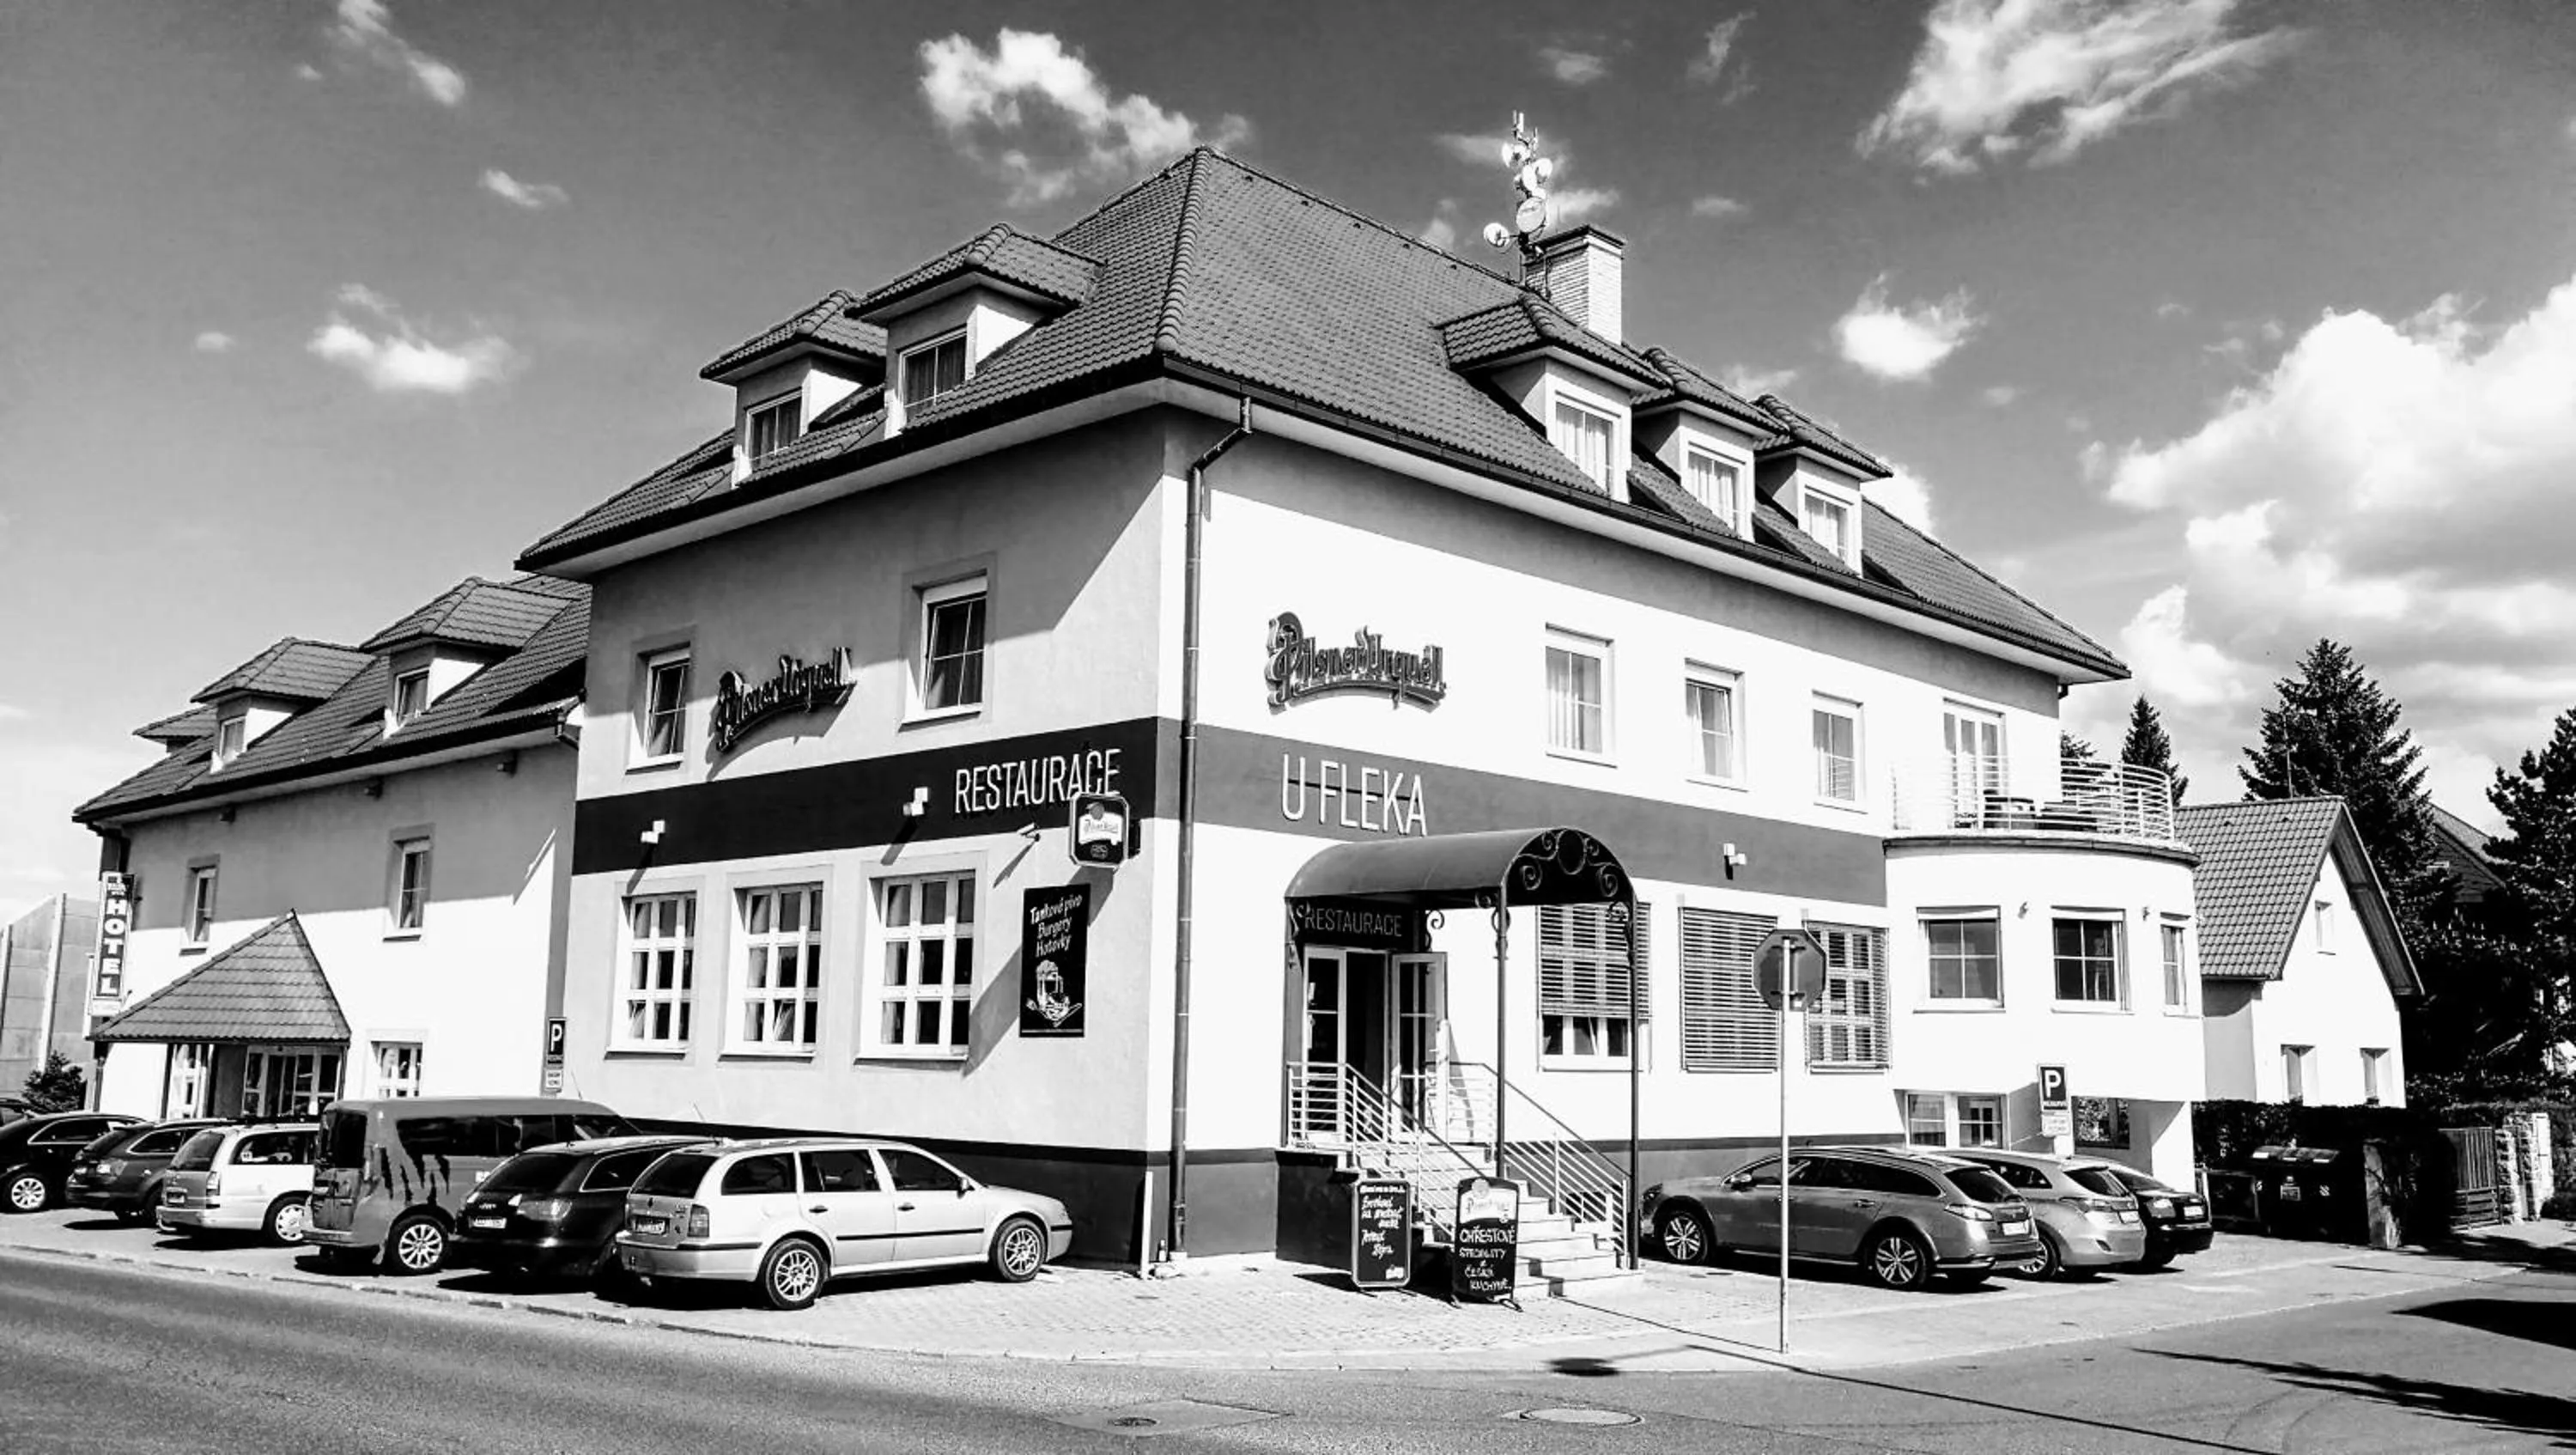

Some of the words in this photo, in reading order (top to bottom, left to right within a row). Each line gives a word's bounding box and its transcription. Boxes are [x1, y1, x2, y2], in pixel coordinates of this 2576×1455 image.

[1264, 611, 1368, 704] Pilsner
[1356, 625, 1444, 703] Urquell
[955, 748, 1121, 813] RESTAURACE
[1282, 753, 1306, 820] U
[1320, 759, 1427, 837] FLEKA
[100, 898, 128, 995] HOTEL
[1304, 907, 1403, 937] RESTAURACE
[550, 1023, 562, 1052] P
[2044, 1069, 2062, 1098] P
